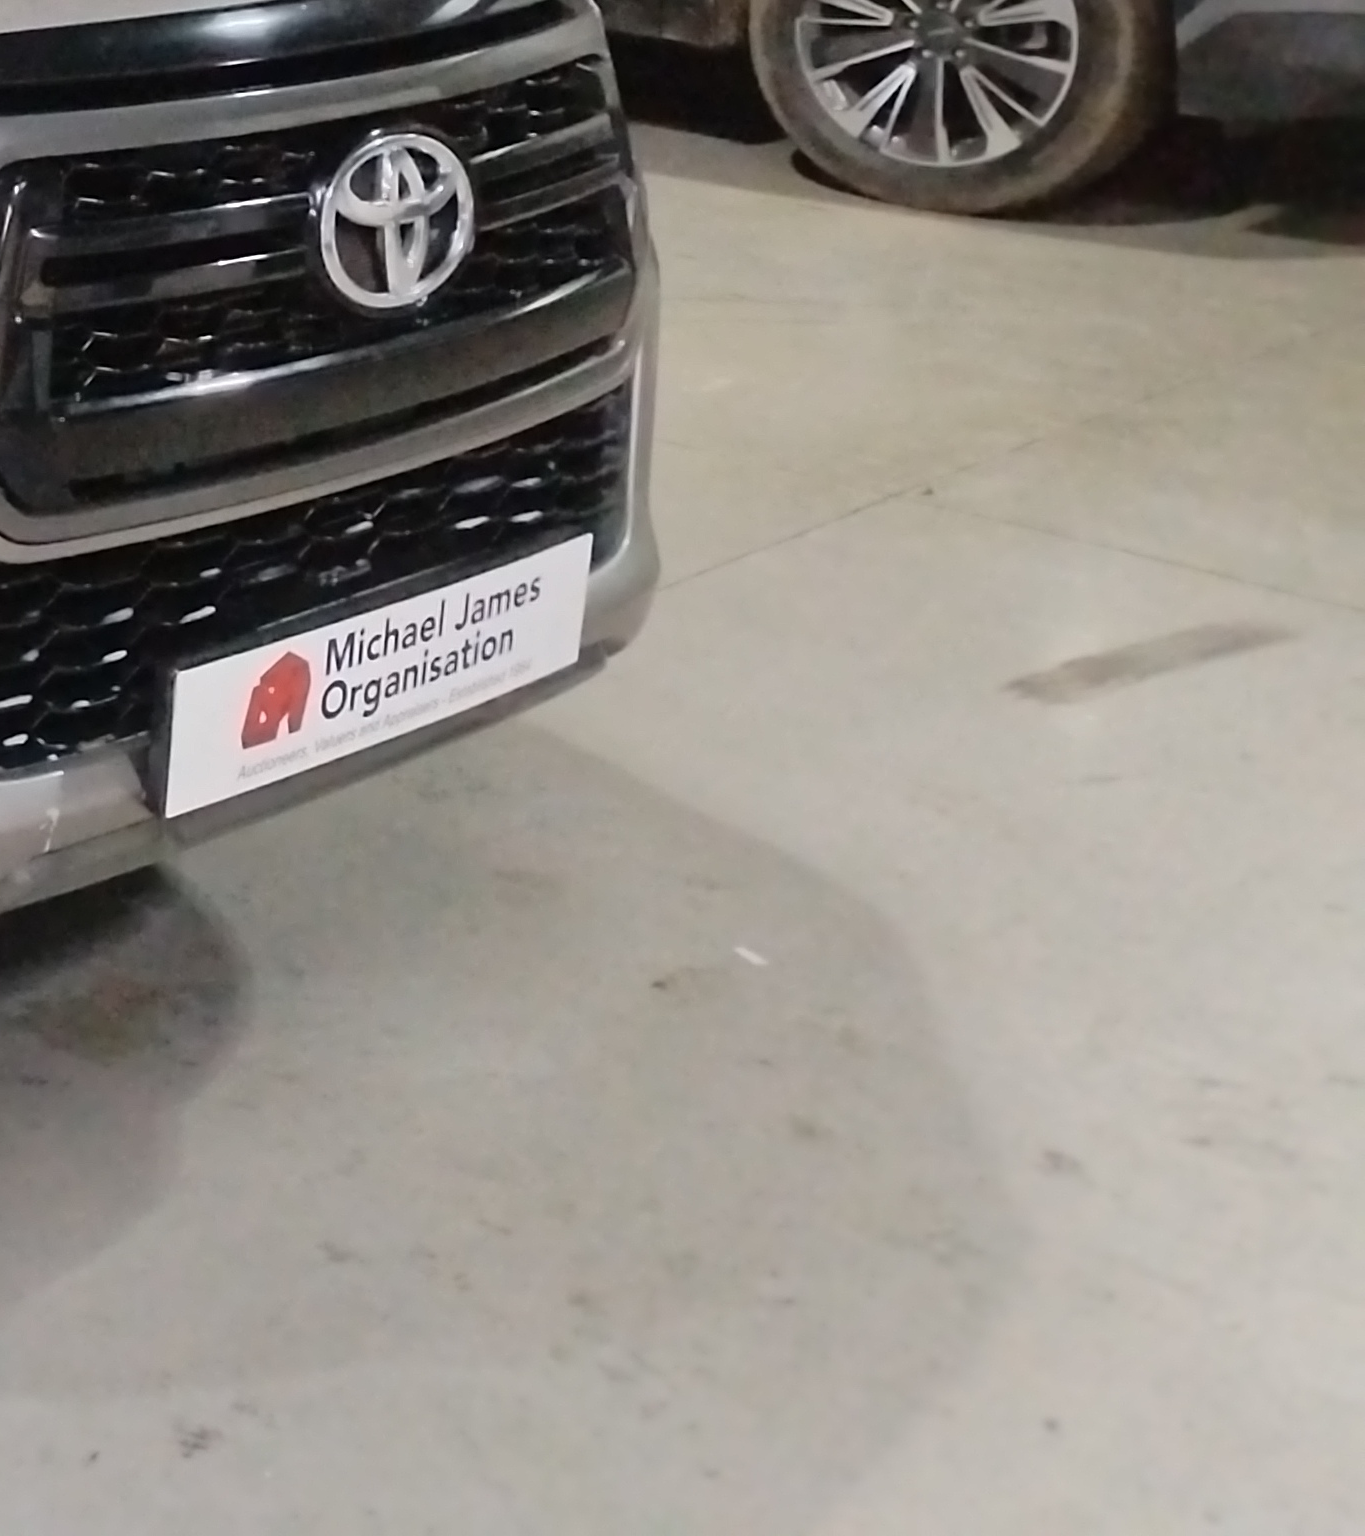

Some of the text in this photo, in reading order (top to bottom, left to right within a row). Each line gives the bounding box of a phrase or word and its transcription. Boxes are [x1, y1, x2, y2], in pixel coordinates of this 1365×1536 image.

[320, 628, 515, 719] Organisation
[324, 576, 542, 677] Michael James
